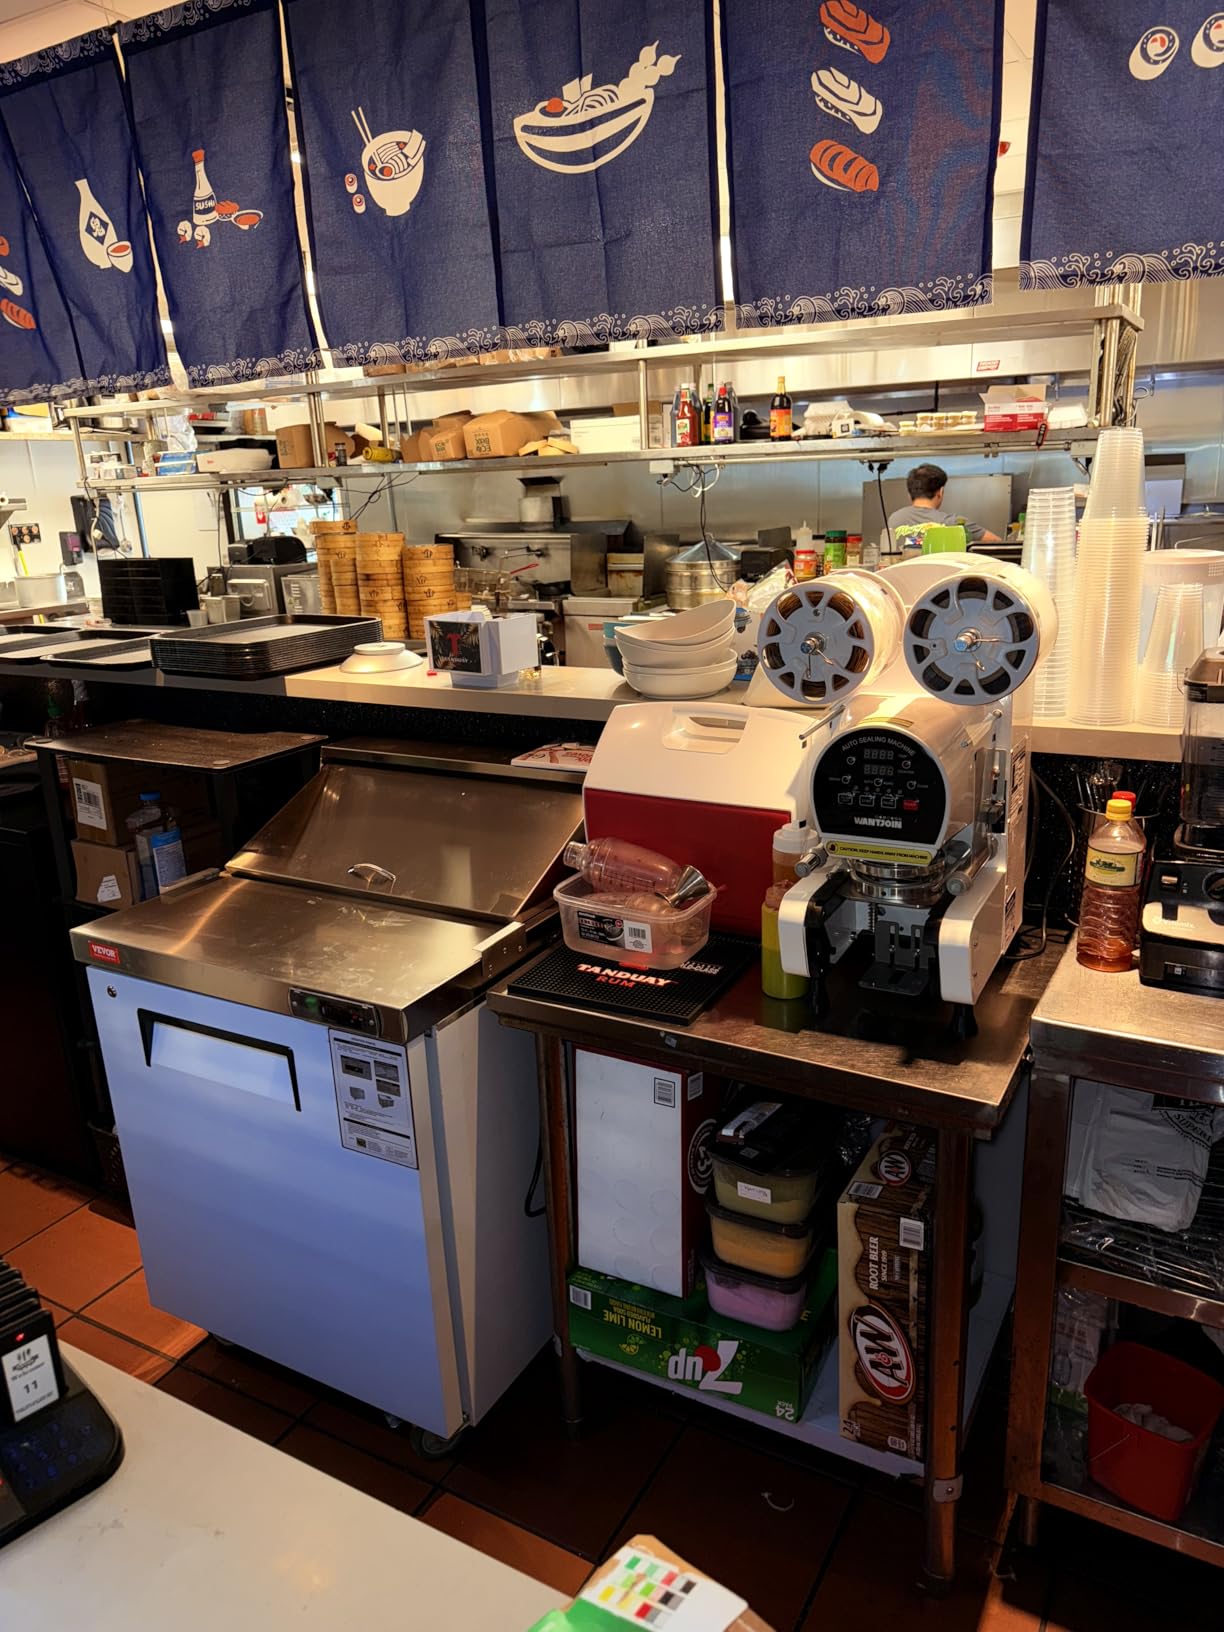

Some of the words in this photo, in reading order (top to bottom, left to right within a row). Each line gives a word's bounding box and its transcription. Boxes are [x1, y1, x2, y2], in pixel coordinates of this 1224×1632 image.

[195, 200, 216, 211] SUSHI
[841, 740, 858, 752] AUTO
[858, 735, 887, 744] SEALING
[887, 738, 916, 756] MACHINE
[91, 944, 116, 958] VEVOR
[577, 963, 672, 986] TANDUAY
[596, 976, 636, 988] RUM
[868, 1236, 879, 1262] BEER
[868, 1262, 879, 1291] ROOT
[881, 1264, 889, 1281] SINCE
[602, 1309, 626, 1327] LIME
[628, 1317, 662, 1339] LEMON
[854, 1316, 912, 1388] A&W
[668, 1340, 743, 1395] 7up
[24, 1380, 38, 1394] 11
[775, 1405, 795, 1421] 24
[777, 1400, 793, 1409] PACK
[843, 1420, 854, 1435] 24
